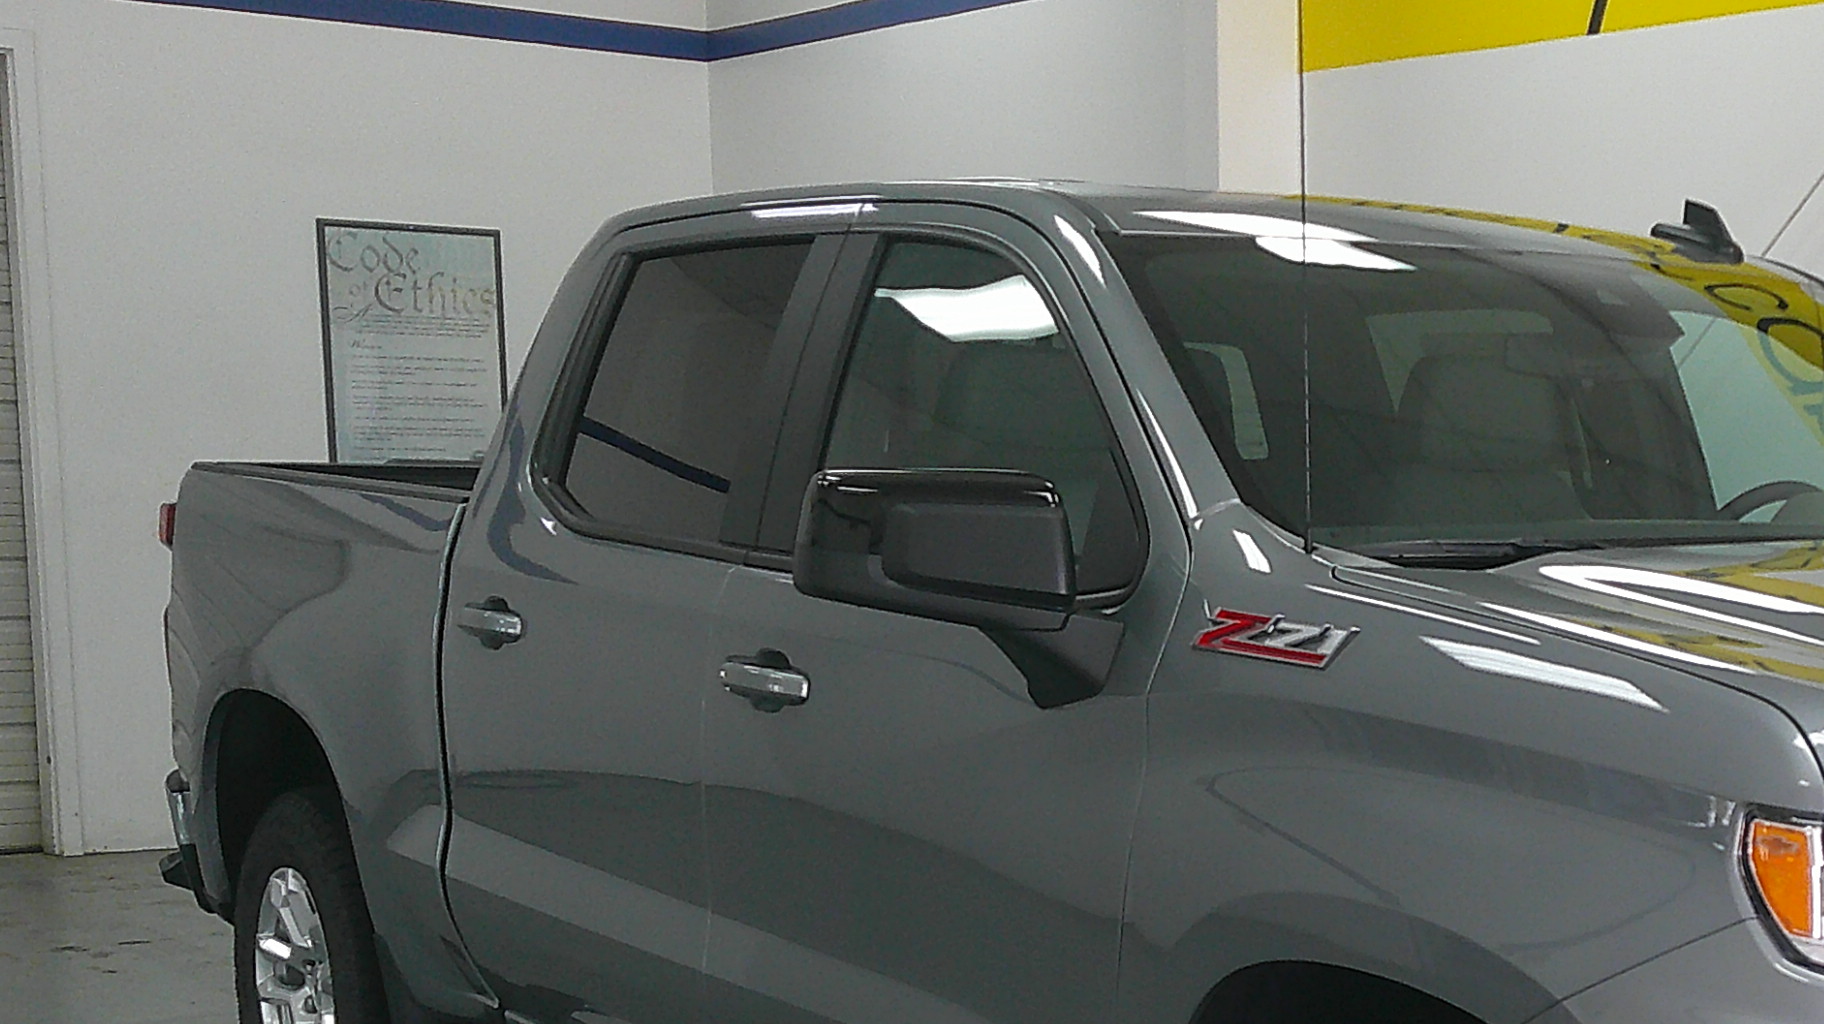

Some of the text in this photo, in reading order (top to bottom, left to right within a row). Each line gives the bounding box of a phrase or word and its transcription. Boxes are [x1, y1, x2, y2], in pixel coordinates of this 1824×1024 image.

[326, 231, 421, 274] Code
[375, 272, 496, 317] Ethics
[1191, 602, 1361, 670] Z71
